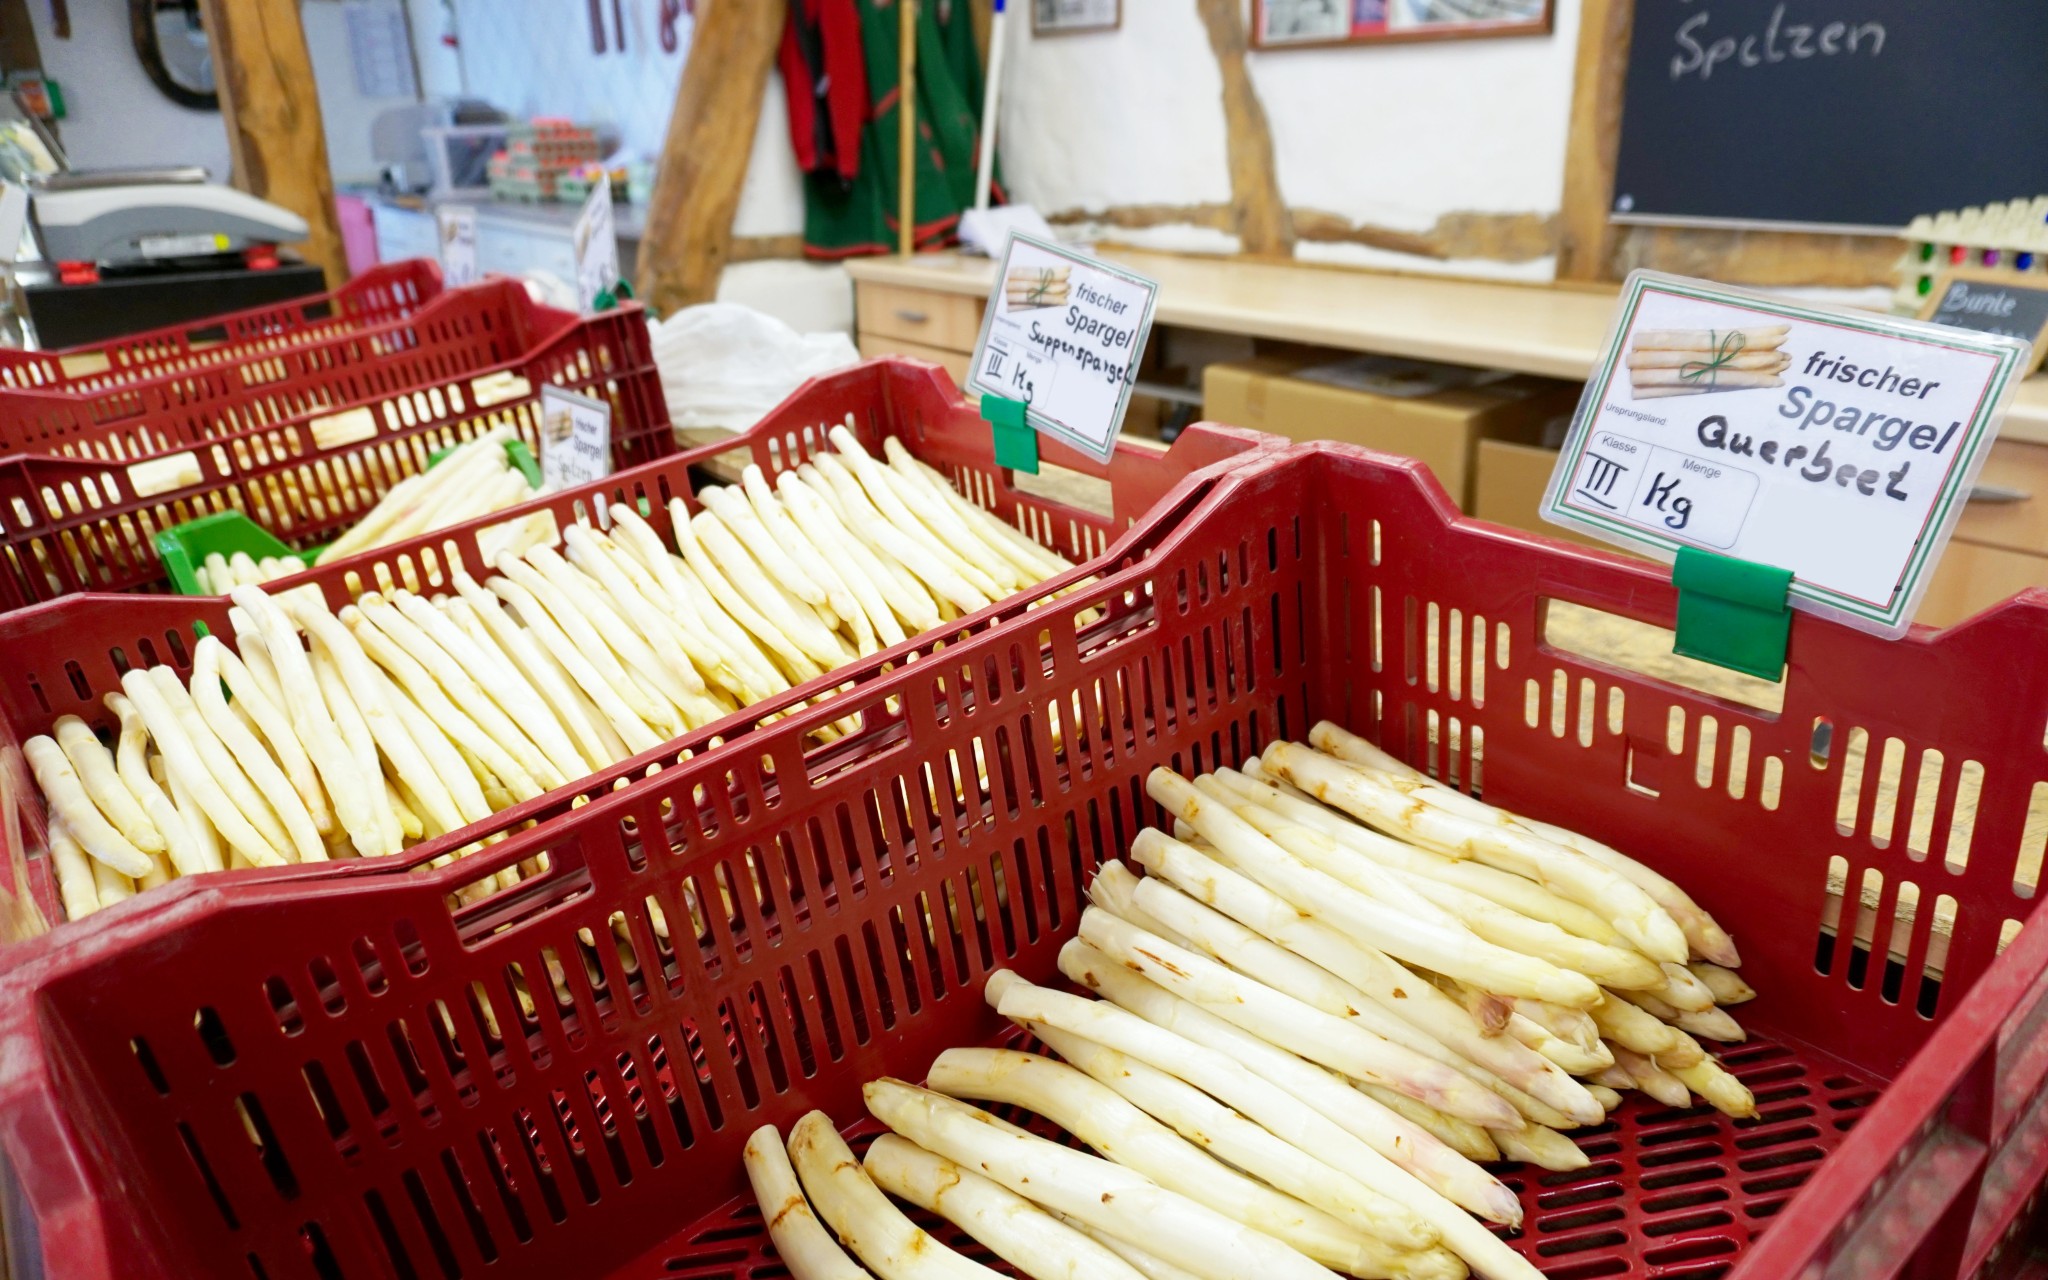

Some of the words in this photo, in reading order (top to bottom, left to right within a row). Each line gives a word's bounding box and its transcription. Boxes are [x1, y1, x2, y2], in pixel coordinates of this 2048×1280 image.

[1075, 282, 1128, 315] frischer
[1065, 305, 1134, 349] Spargel
[1028, 320, 1133, 386] Suppenspargel
[1803, 350, 1941, 400] frischer
[1012, 362, 1033, 404] Kg
[1778, 386, 1961, 454] Spargel
[573, 434, 603, 461] Spargel
[1602, 435, 1638, 454] Klasse
[1698, 414, 1911, 501] Querbeet
[1682, 458, 1722, 478] Menge
[1643, 471, 1693, 529] Kg
